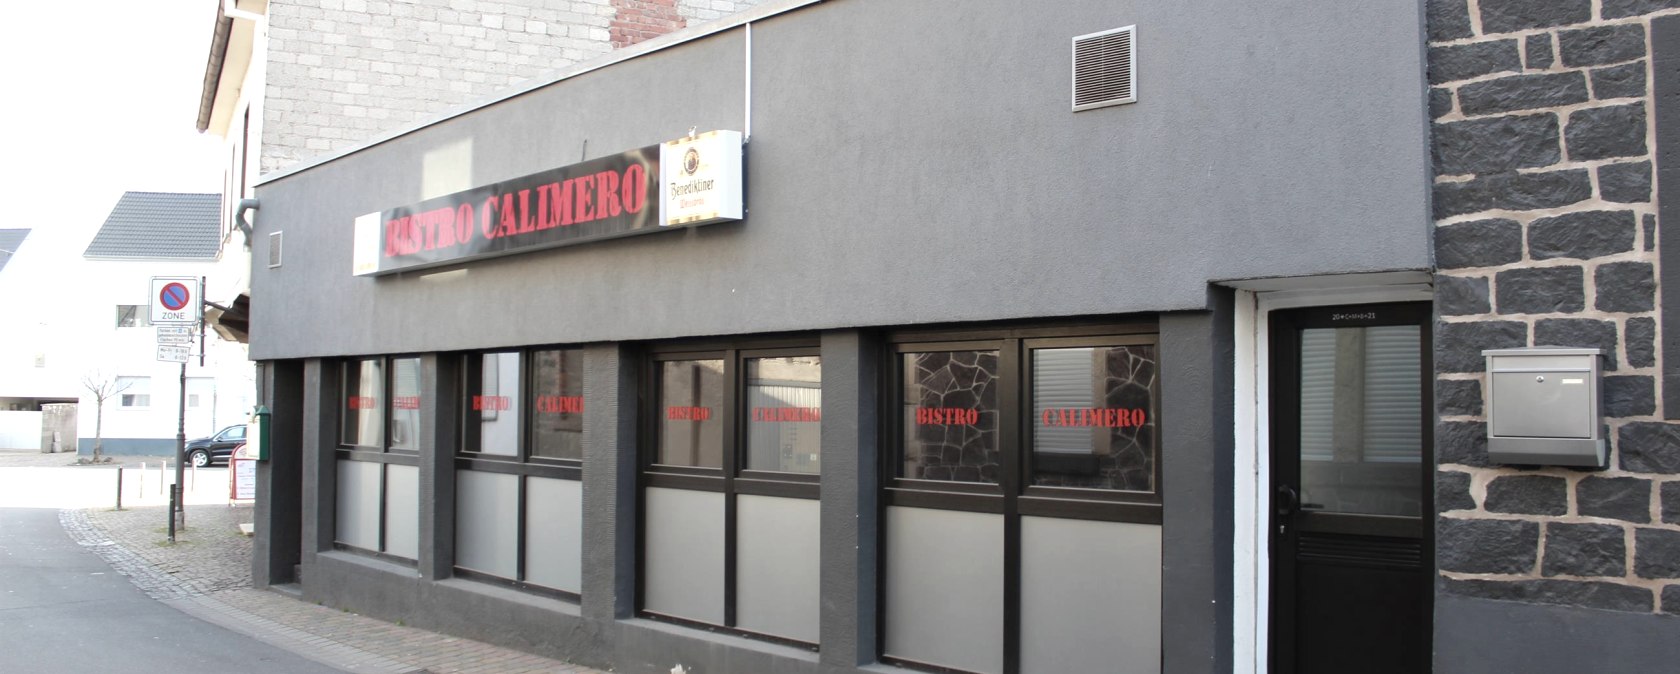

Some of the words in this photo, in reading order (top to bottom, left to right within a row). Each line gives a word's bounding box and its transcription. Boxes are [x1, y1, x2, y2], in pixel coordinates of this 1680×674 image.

[670, 179, 714, 200] Benediktiner
[385, 203, 474, 257] BISTRO
[482, 163, 645, 239] CALIMERO
[472, 395, 510, 410] BISTRO
[667, 405, 710, 421] BISTRO
[915, 407, 978, 426] BISTRO
[1042, 407, 1146, 428] CALIMERO
